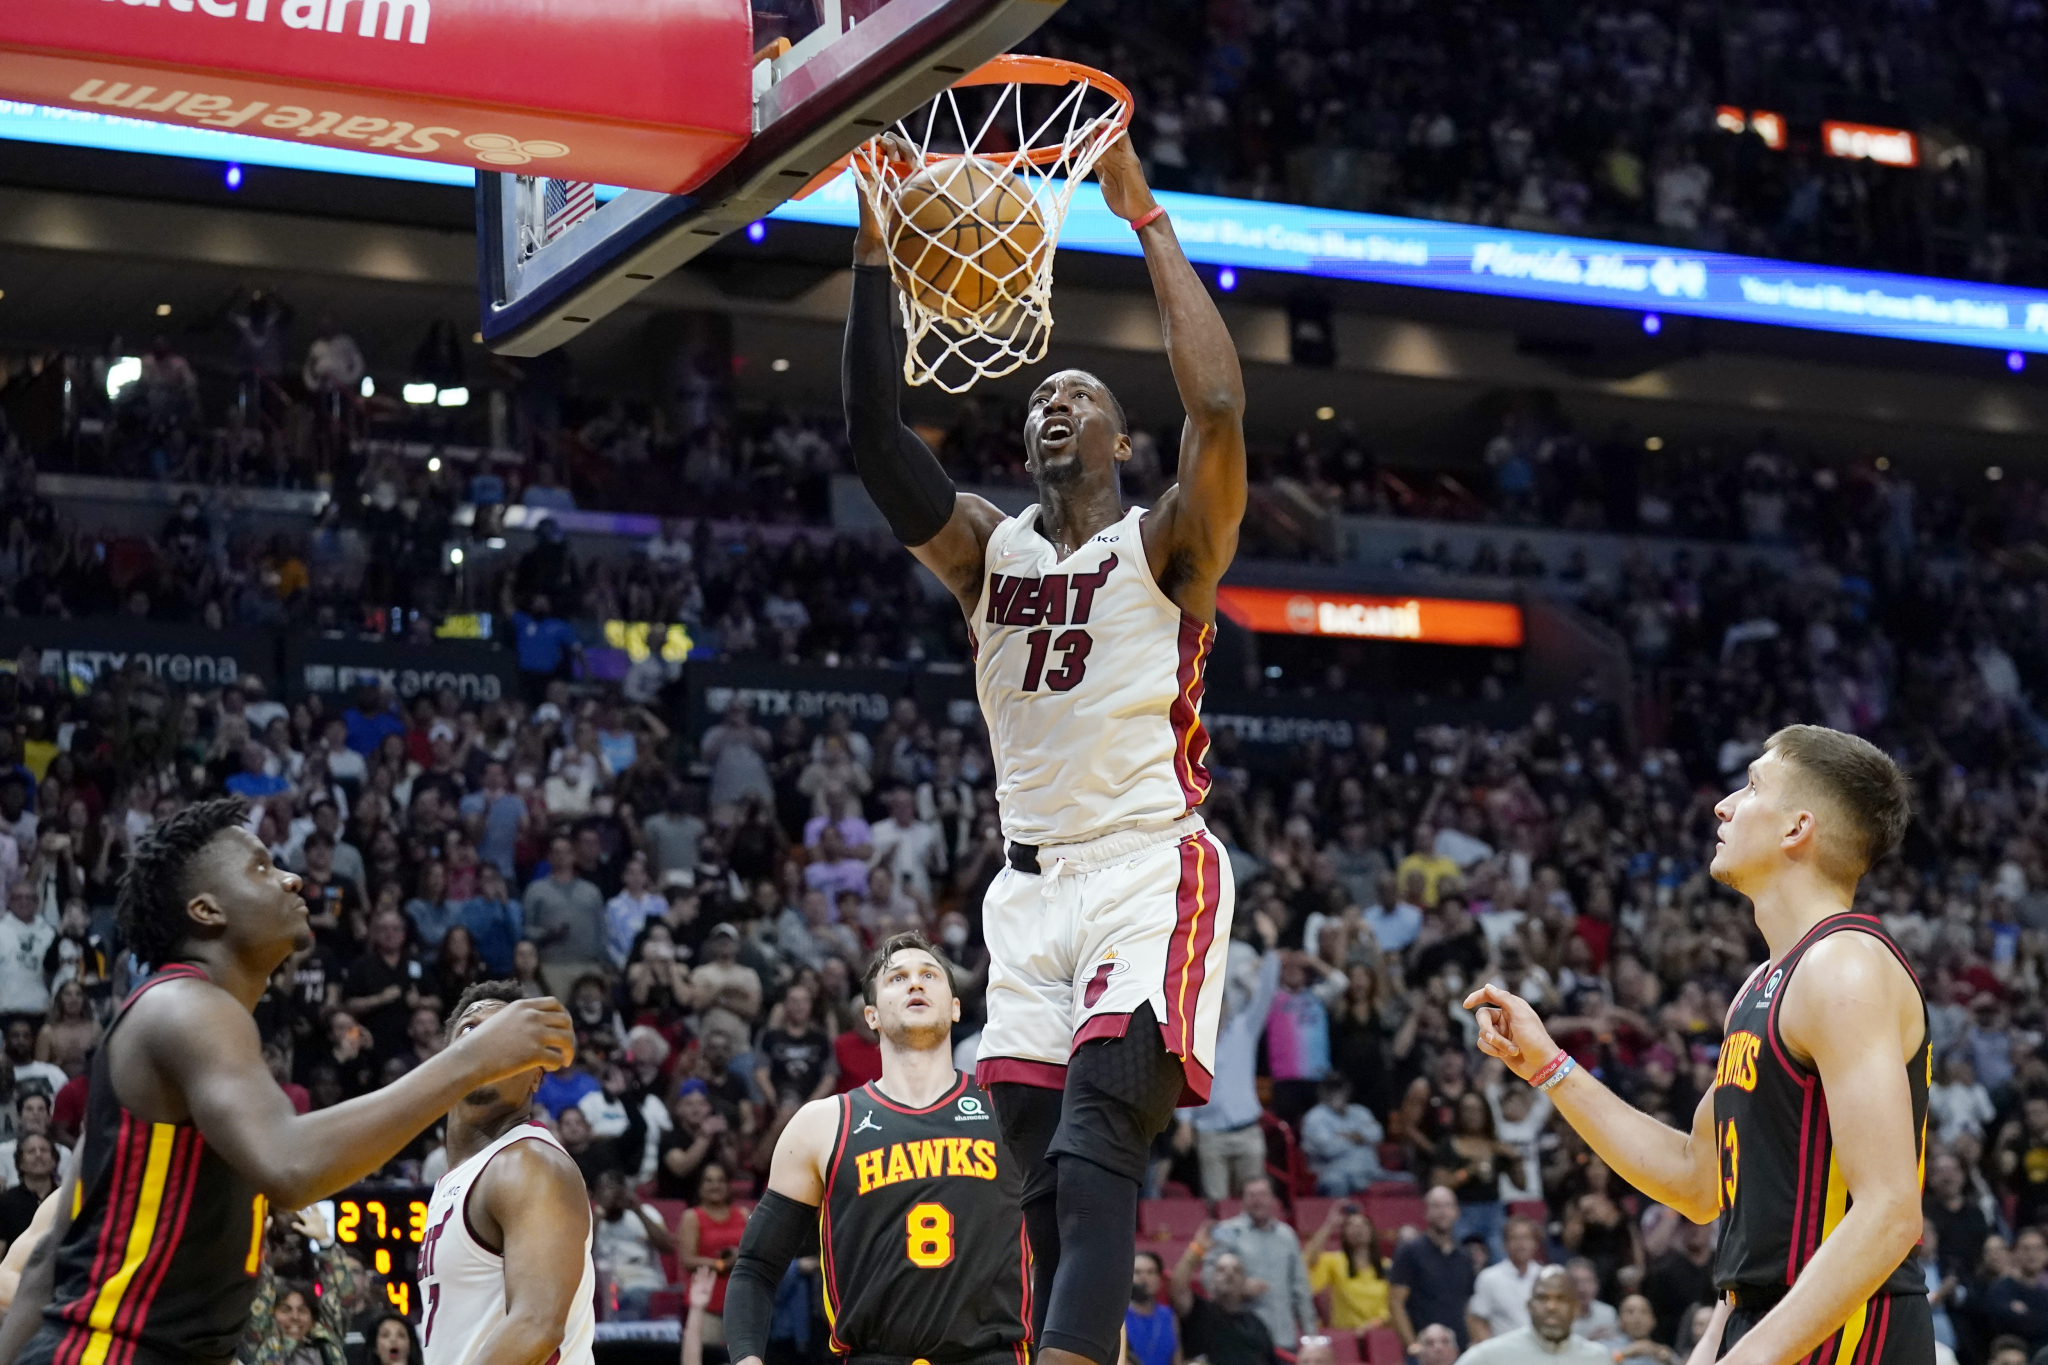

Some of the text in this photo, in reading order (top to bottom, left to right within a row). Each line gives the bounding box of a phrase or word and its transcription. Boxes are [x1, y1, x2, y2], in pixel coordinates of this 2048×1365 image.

[1472, 242, 1648, 291] Florida Blue
[986, 552, 1119, 626] HEAT
[1022, 629, 1093, 692] 13
[955, 1114, 989, 1122] sharecare
[855, 1137, 997, 1196] HAWKS
[337, 1201, 428, 1243] 27.3
[906, 1202, 954, 1268] 8
[386, 1282, 409, 1316] 4
[424, 1282, 440, 1347] 7
